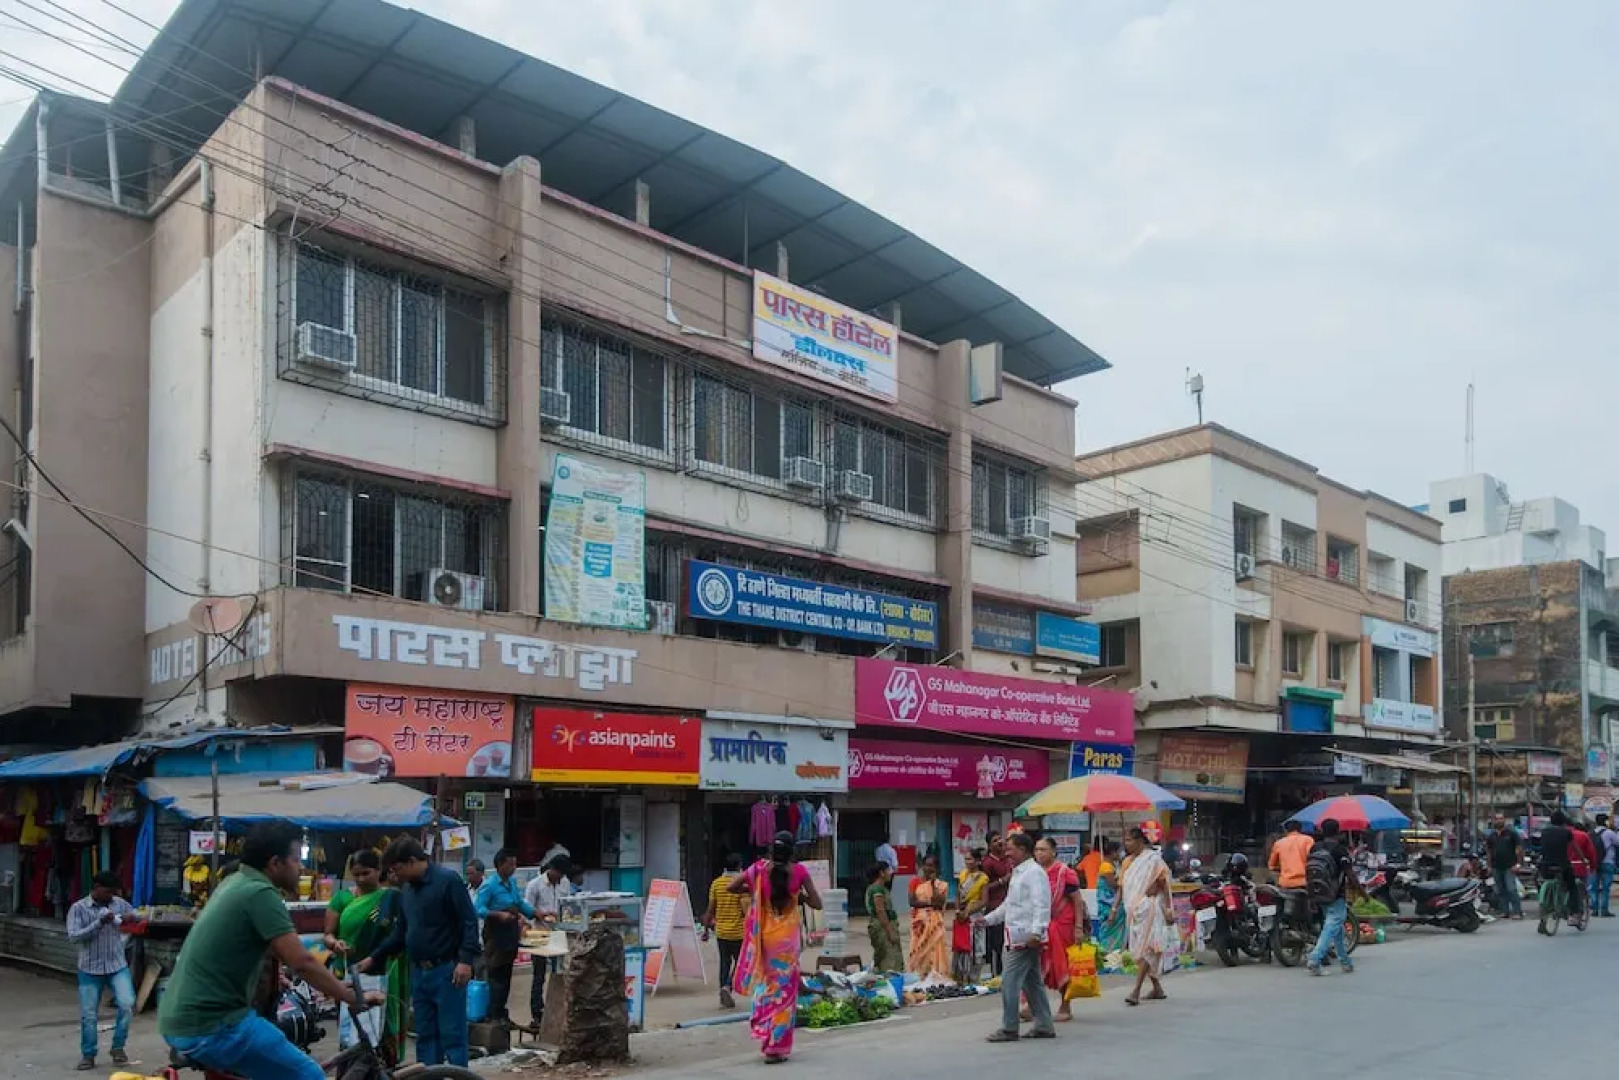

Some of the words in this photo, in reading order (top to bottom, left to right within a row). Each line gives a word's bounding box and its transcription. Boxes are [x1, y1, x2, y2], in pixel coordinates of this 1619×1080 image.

[759, 285, 826, 332] पारस
[830, 313, 891, 356] हॉटेल
[737, 600, 752, 616] THE
[753, 602, 774, 620] THANE
[776, 606, 804, 624] DISTRICT
[805, 611, 832, 629] CENTRAL
[332, 614, 487, 670] पारस
[495, 632, 638, 692] प्लाझा
[927, 677, 942, 691] GS
[943, 679, 1000, 700] Mahanagar
[1000, 686, 1055, 704] Co-operative
[1056, 693, 1076, 706] Bank
[356, 693, 407, 717] जय
[414, 696, 505, 728] महाराष्ट्र
[392, 725, 417, 752] टी
[424, 726, 473, 753] सेंटर
[588, 726, 676, 754] asianpaints
[709, 730, 787, 765] प्रामाणिक
[1083, 747, 1123, 768] Paras
[1162, 751, 1192, 768] HOT
